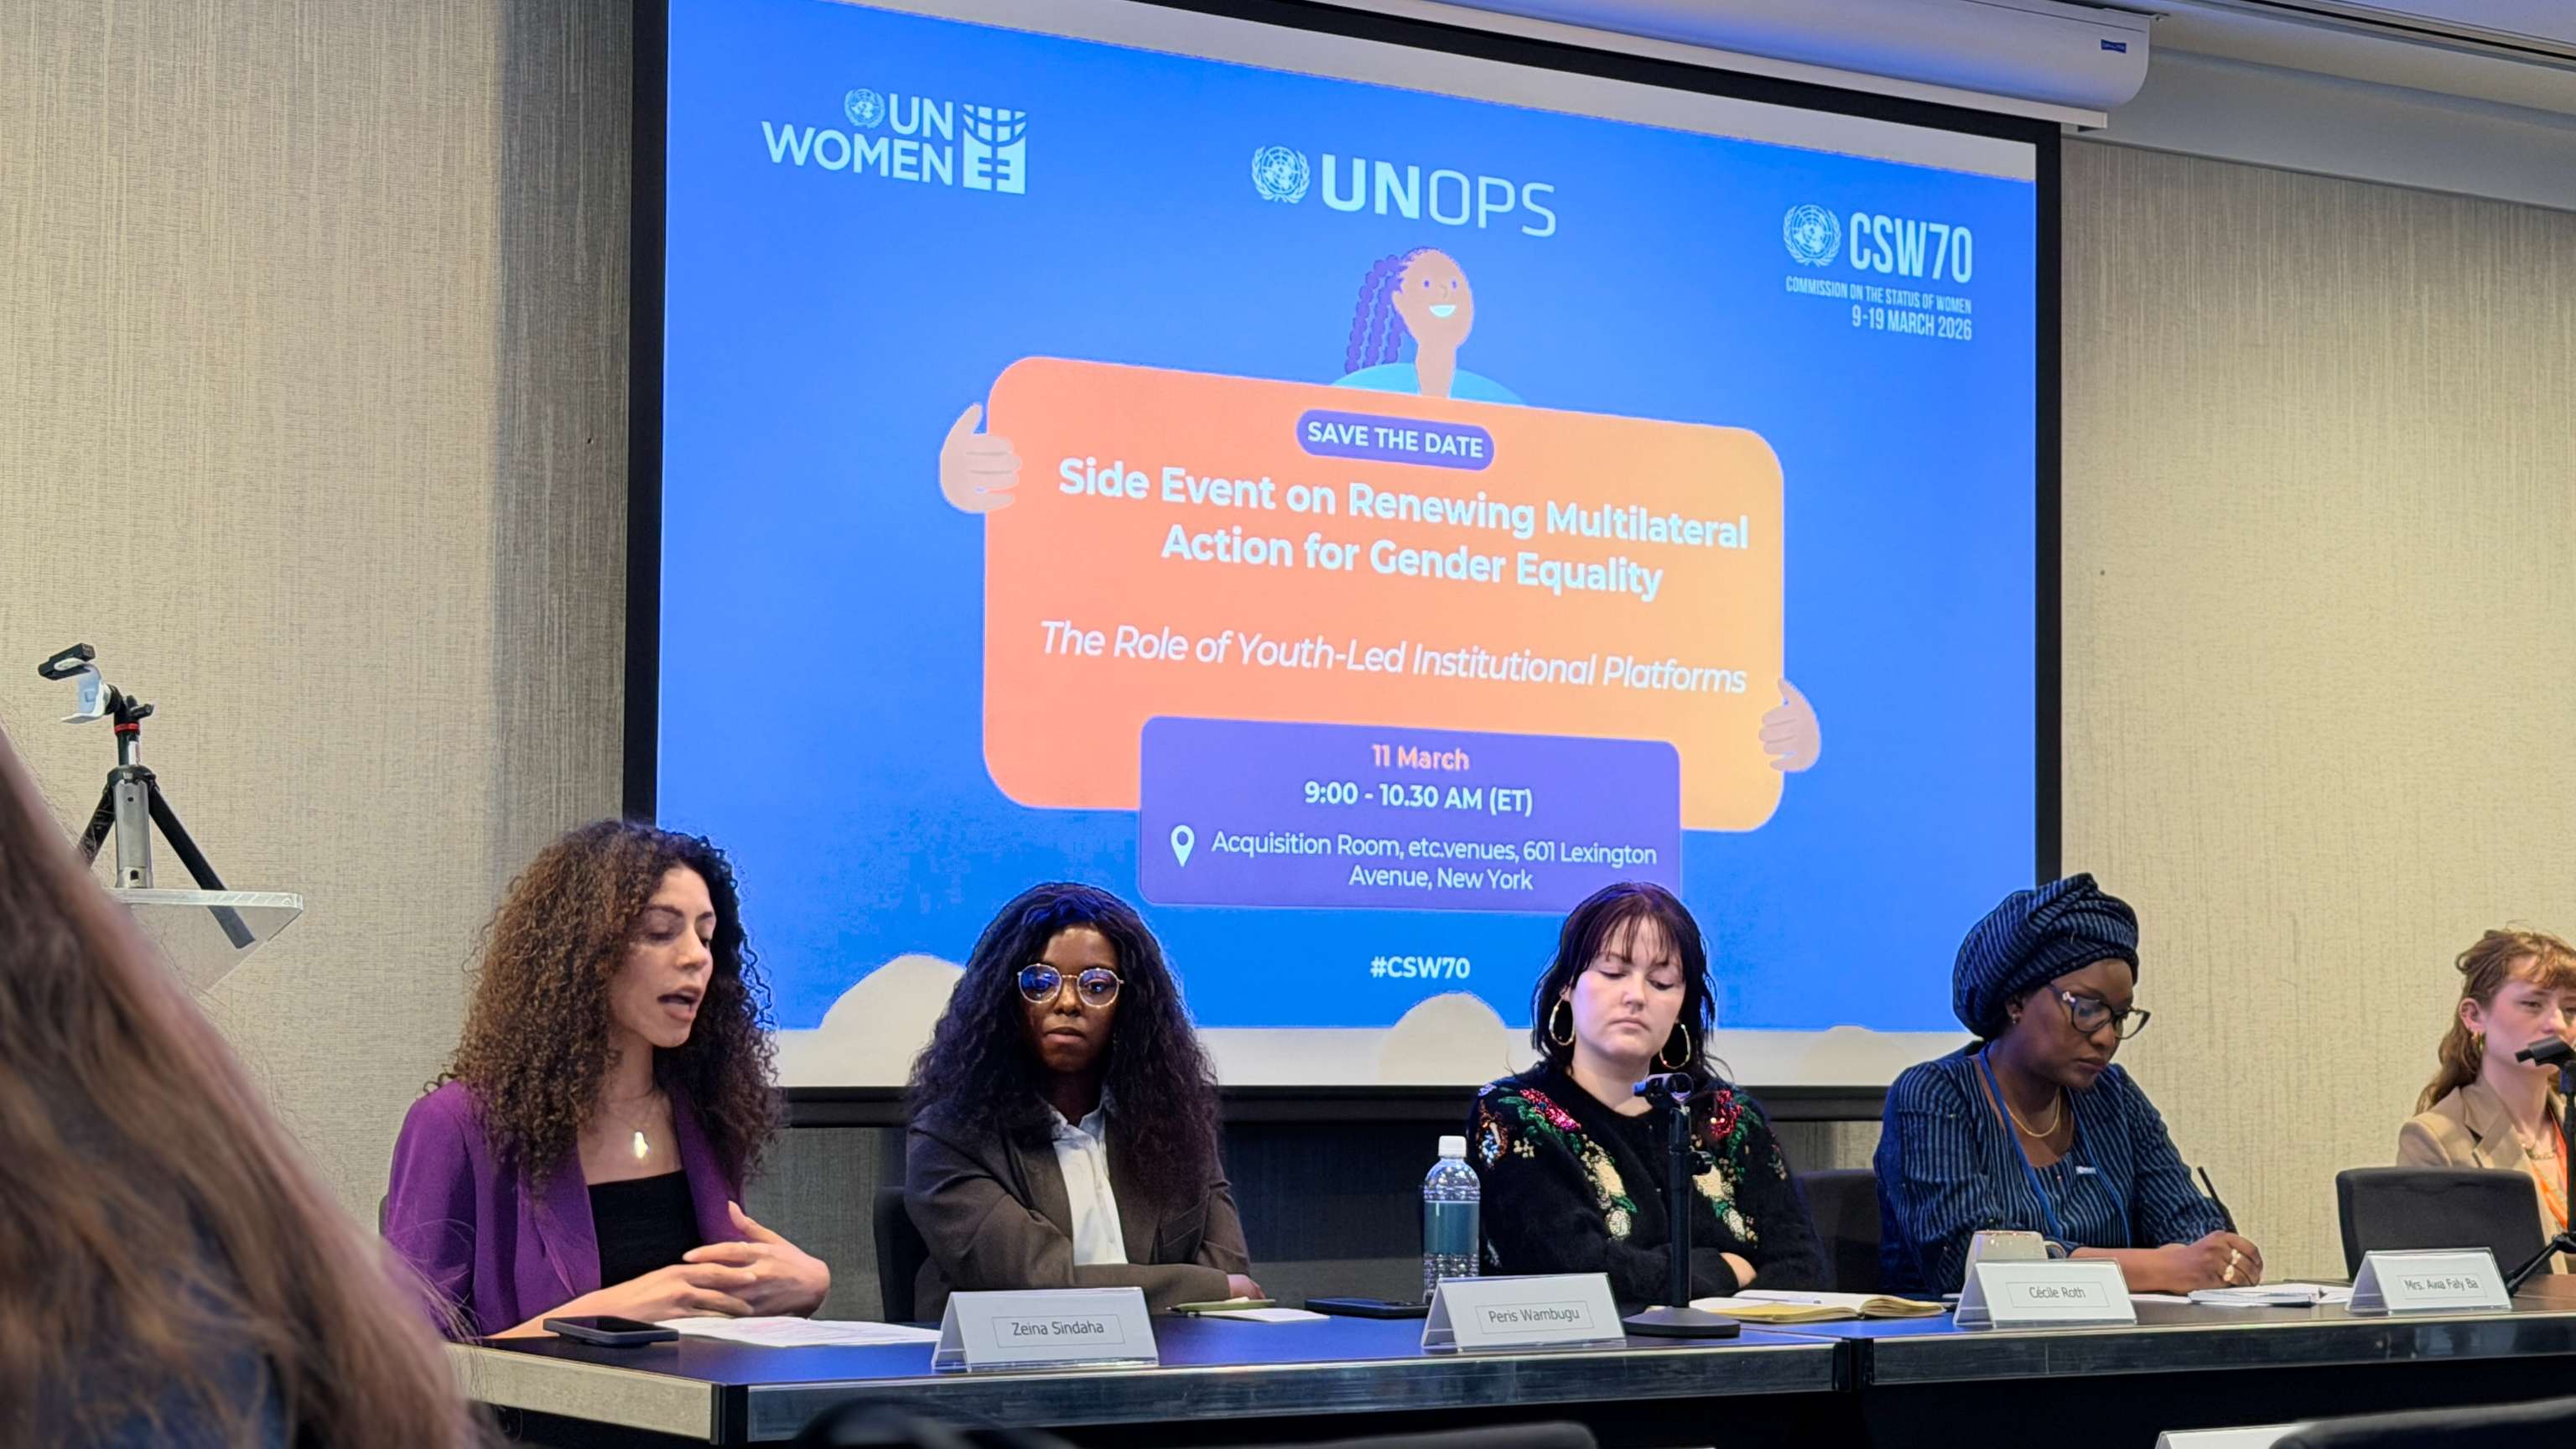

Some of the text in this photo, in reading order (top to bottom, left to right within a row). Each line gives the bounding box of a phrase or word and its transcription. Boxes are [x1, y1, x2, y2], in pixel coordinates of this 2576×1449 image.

[890, 93, 954, 141] UN
[761, 121, 953, 186] WOMEN
[1322, 153, 1556, 237] UNOPS
[1850, 211, 1972, 283] CSW70
[1785, 275, 1971, 314] COMMISSION ON THE STATUS OF WOMEN
[1852, 304, 1972, 341] 9-19 MARCH 2026
[1307, 421, 1483, 459] SAVE THE DATE
[1059, 456, 1749, 550] Side Event on Renewing Multilateral
[1161, 523, 1664, 603] Action for Gender Equality
[1041, 619, 1748, 694] The Role of Youth-Led Institutional Platforms
[1372, 744, 1470, 771] 11 March
[1304, 781, 1358, 805] 9:00
[1379, 783, 1439, 809] 10.30
[1444, 786, 1483, 810] AM
[1489, 786, 1533, 817] (ET)
[1211, 830, 1657, 869] Acquisition Room, etc.venues, 601 Lexington
[1348, 865, 1534, 891] Avenue, New York
[1370, 955, 1471, 979] #CSW70
[2028, 1285, 2086, 1299] Cécile Roth
[2404, 1279, 2423, 1291] Mrs.
[2466, 1278, 2479, 1289] Ba
[1011, 1321, 1104, 1337] Zeina Sindaha
[1488, 1307, 1580, 1323] Peris Wambugu
